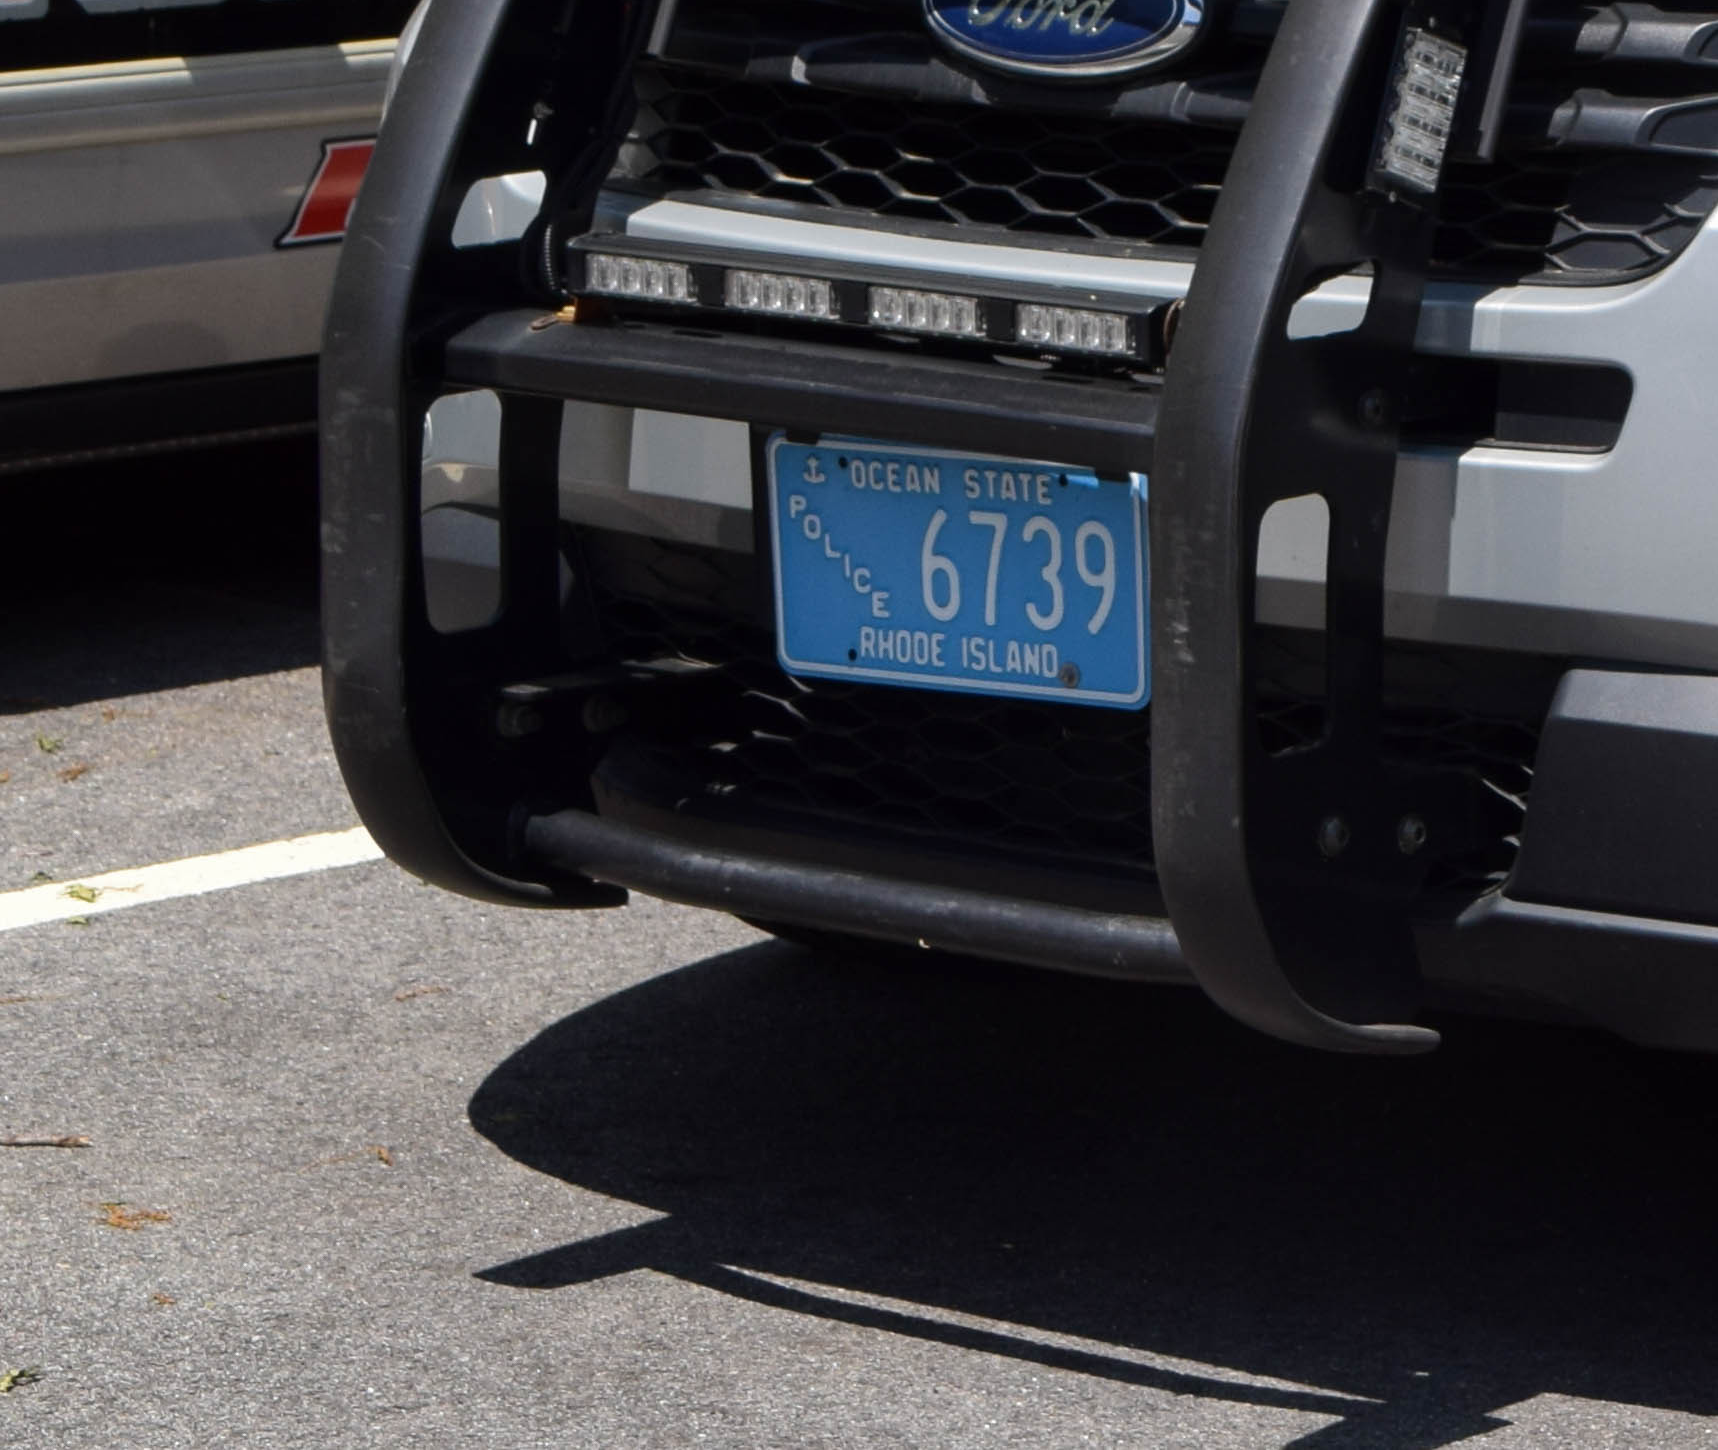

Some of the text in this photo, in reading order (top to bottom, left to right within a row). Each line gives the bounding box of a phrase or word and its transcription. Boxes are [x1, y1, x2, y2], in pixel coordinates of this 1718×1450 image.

[850, 458, 1053, 505] OCEAN STATE
[788, 494, 891, 619] POLICE
[921, 508, 1116, 636] 6739
[859, 625, 1060, 678] RHODE ISLAND
